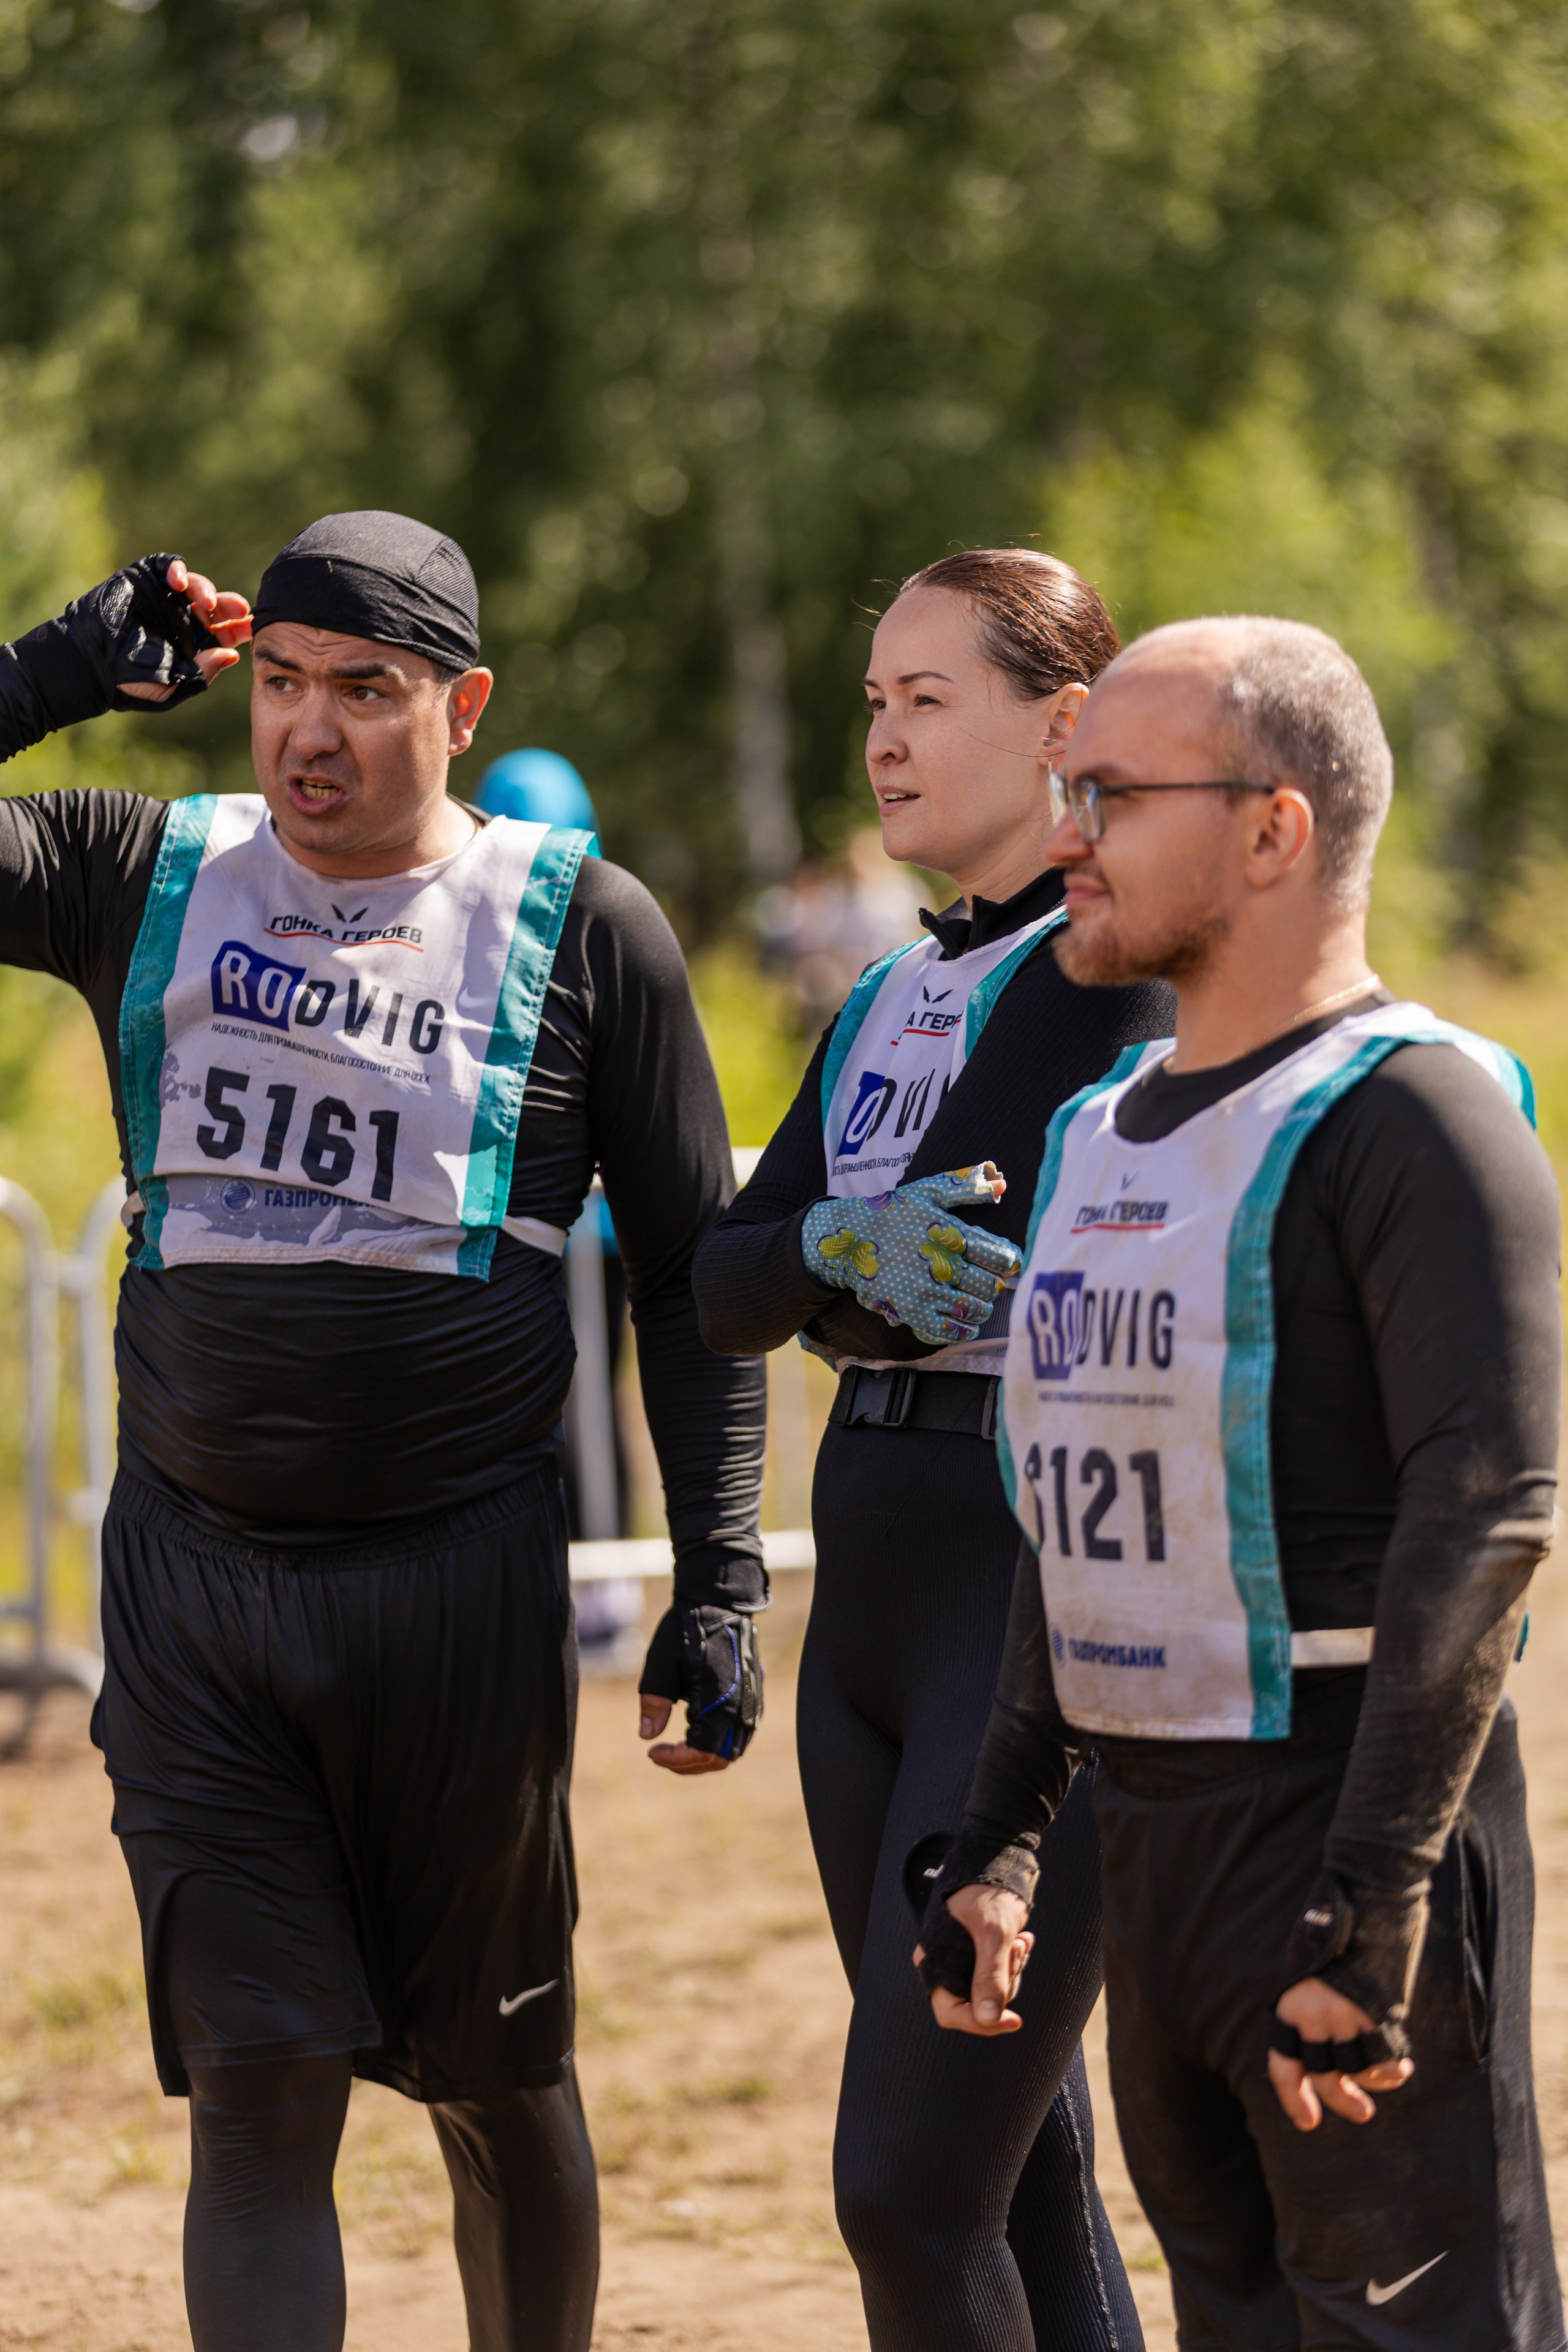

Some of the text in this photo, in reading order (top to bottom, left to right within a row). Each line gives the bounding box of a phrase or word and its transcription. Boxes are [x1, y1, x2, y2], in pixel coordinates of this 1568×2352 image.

[270, 915, 423, 943] ГОНКА ГЕРОЕВ
[220, 949, 445, 1054] RODVIG
[211, 1022, 257, 1041] НАДЕЖНОСТЬ
[258, 1032, 273, 1044] ДЛЯ
[330, 1052, 393, 1075] БЛАГОСОСТОЯНИЕ
[394, 1067, 410, 1078] ДЛЯ
[411, 1072, 431, 1083] ВСЕХ
[196, 1066, 400, 1202] 5161
[1031, 1289, 1175, 1370] RODVIG
